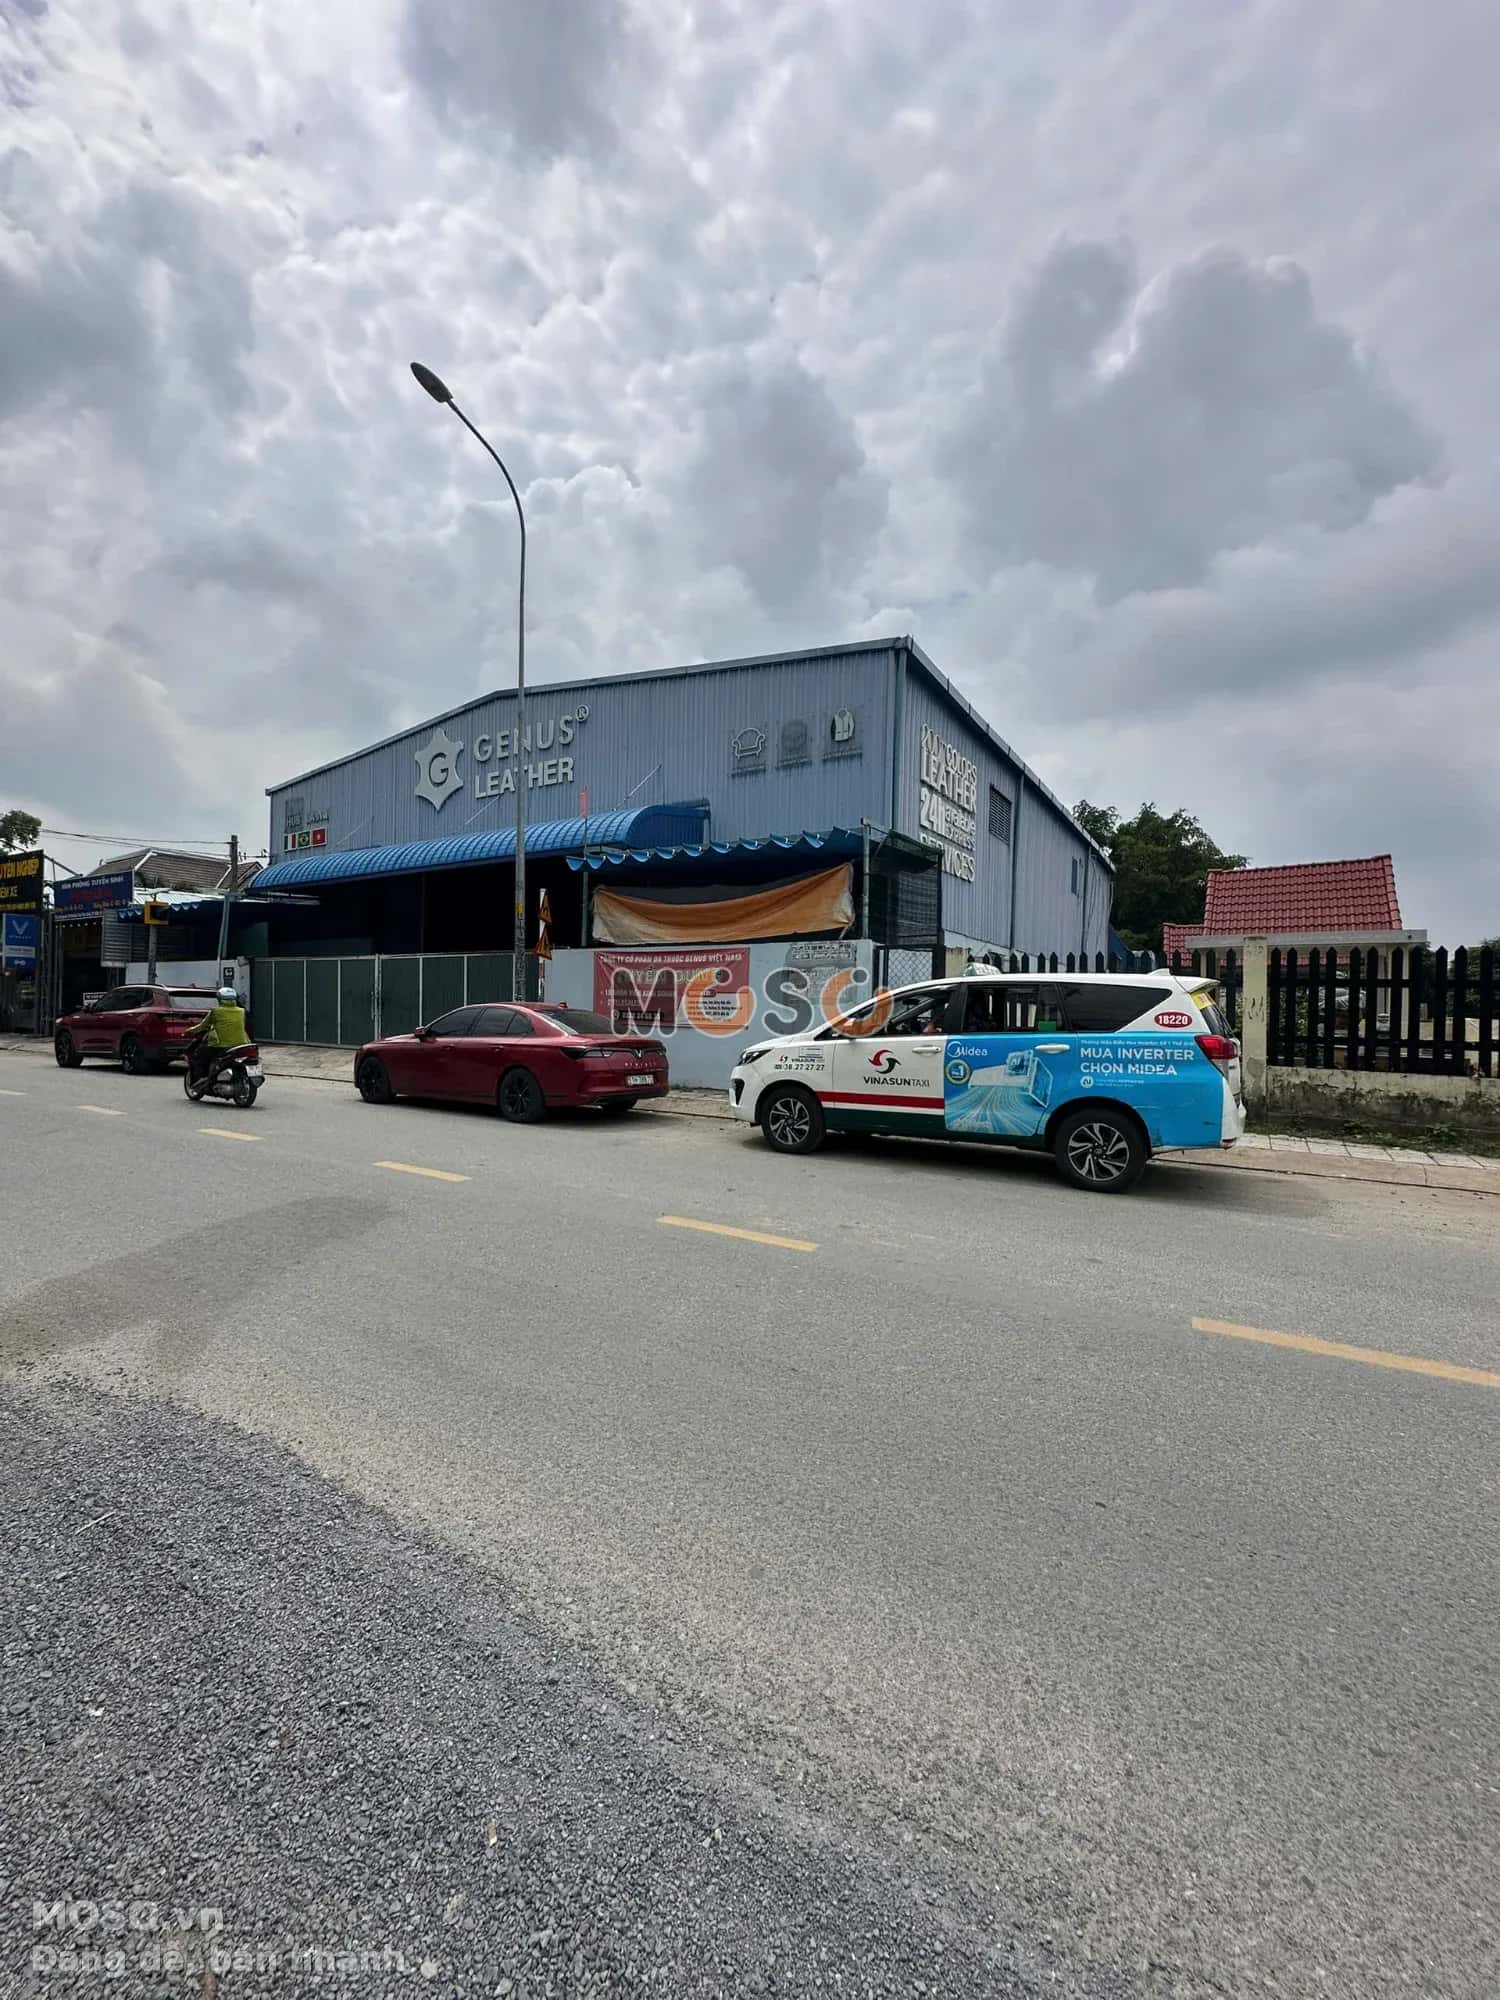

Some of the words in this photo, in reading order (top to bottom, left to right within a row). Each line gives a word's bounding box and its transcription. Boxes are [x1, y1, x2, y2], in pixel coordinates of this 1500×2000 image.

[429, 752, 449, 786] G
[474, 757, 575, 799] LEAHER
[945, 743, 977, 787] COLORS
[920, 748, 977, 814] LEATHER
[1158, 1014, 1188, 1026] 18220
[947, 1040, 988, 1058] Midea
[1080, 1048, 1113, 1059] MUA
[1118, 1049, 1194, 1061] INVERTER
[1080, 1062, 1123, 1077] CHỌN
[1128, 1063, 1177, 1076] MIDEA
